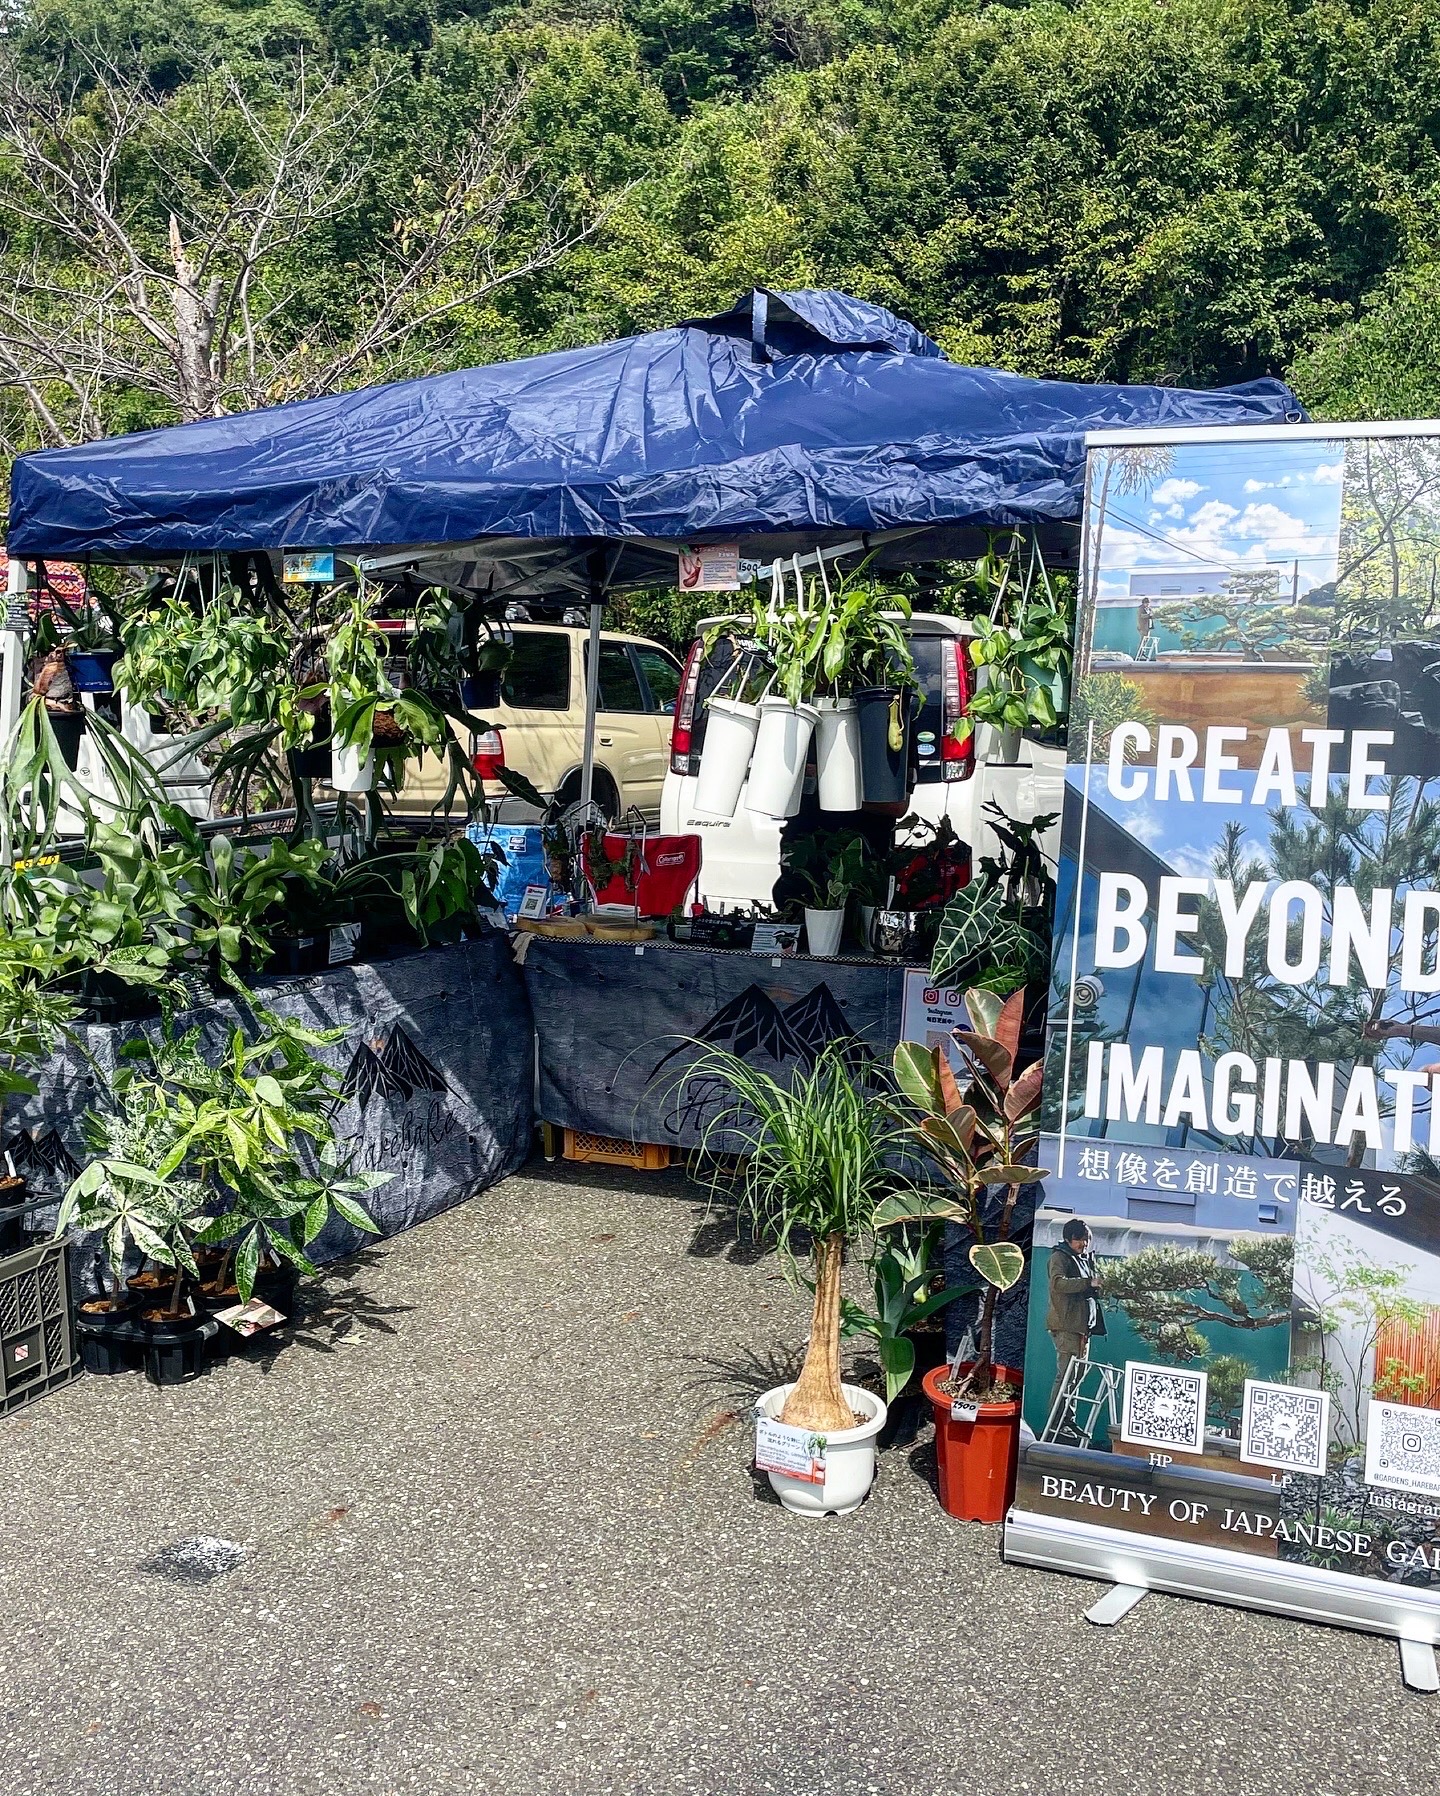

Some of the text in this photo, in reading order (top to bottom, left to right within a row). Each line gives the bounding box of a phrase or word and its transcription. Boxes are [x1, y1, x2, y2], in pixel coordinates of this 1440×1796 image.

[1106, 722, 1393, 810] CREATE
[686, 819, 732, 828] Esquire
[1094, 871, 1440, 993] BEYOND
[1078, 1147, 1407, 1217] 想像を創造で越える
[1148, 1453, 1173, 1468] HP
[1270, 1473, 1294, 1489] LP
[1041, 1475, 1158, 1516] BEAUTY
[1168, 1499, 1209, 1525] OF
[1220, 1509, 1373, 1558] JAPANESE
